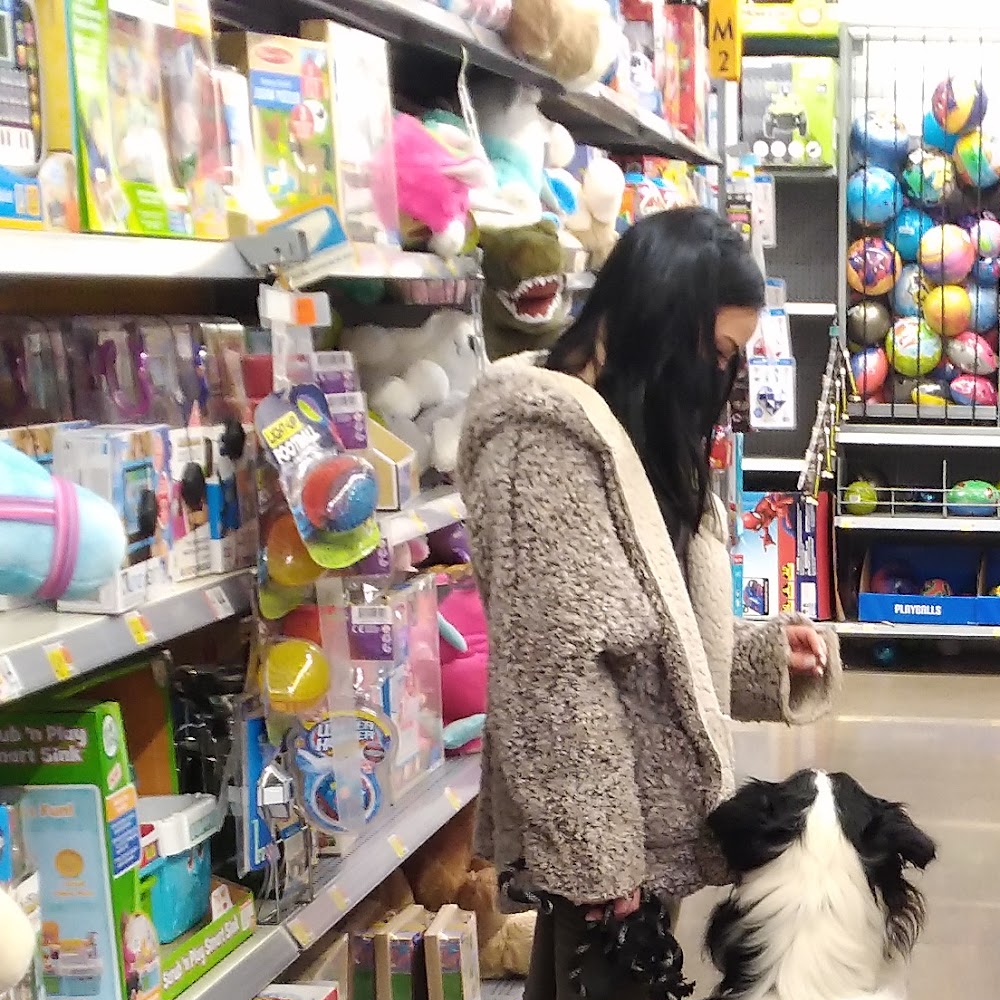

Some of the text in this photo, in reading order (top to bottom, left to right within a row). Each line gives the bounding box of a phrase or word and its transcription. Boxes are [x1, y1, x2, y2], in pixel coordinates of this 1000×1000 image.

[713, 17, 733, 40] M
[719, 50, 728, 71] 2
[894, 603, 942, 616] PLAYBALLS
